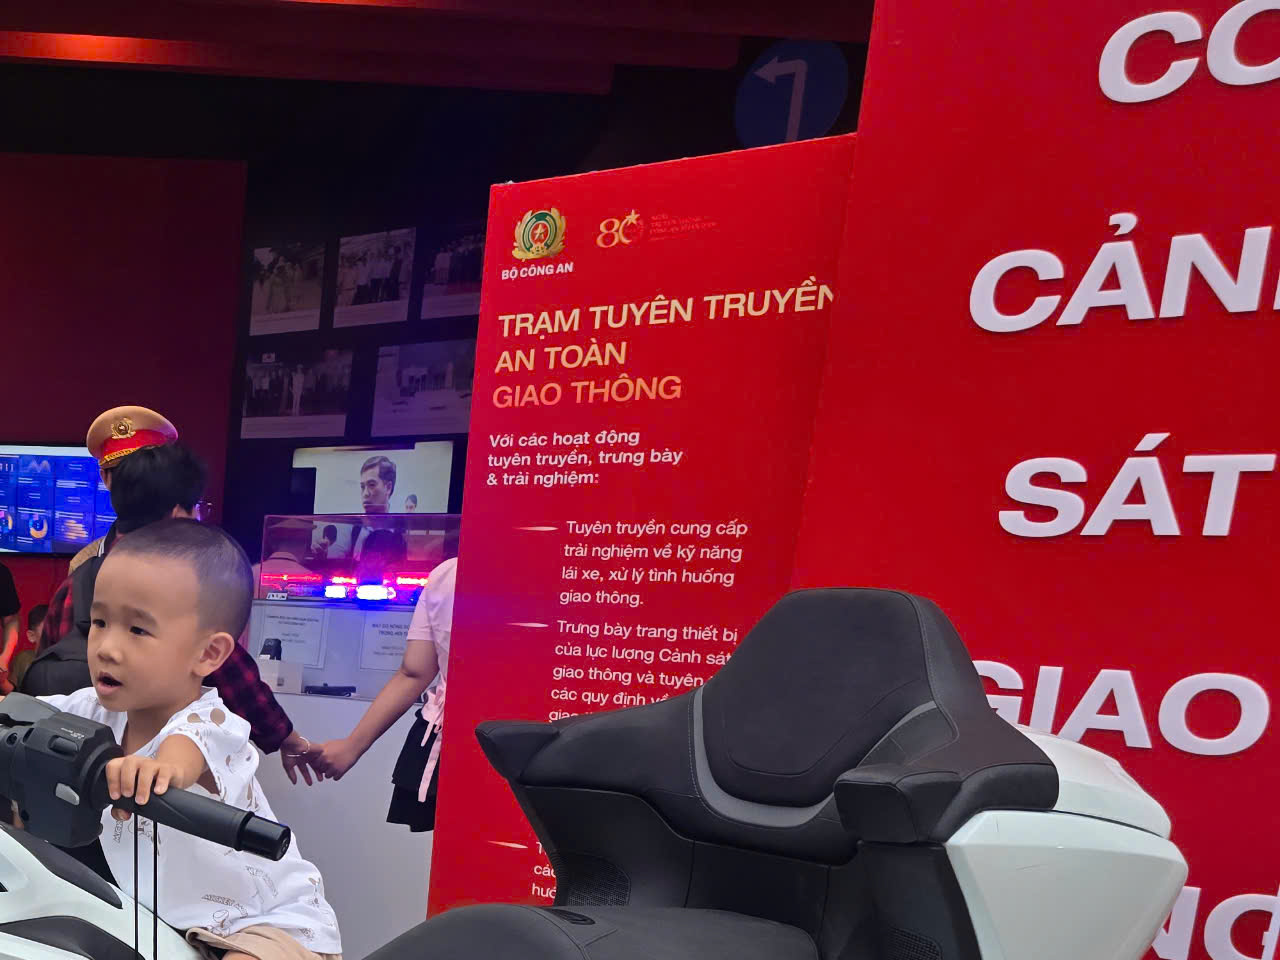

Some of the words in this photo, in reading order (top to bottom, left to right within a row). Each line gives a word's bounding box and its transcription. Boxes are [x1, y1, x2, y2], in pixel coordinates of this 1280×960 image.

[501, 266, 519, 281] BỘ
[520, 263, 554, 278] CÔNG
[556, 262, 574, 273] AN
[969, 212, 1280, 333] CẢN
[498, 308, 581, 340] TRẠM
[589, 294, 694, 330] TUYÊN
[704, 275, 834, 320] TRUYỀN
[494, 349, 536, 373] AN
[544, 337, 627, 370] TOÀN
[492, 382, 562, 409] GIAO
[571, 373, 682, 404] THÔNG
[489, 433, 514, 448] Với
[518, 432, 547, 447] các
[552, 431, 590, 448] hoạt
[595, 429, 640, 447] động
[487, 452, 531, 469] tuyên
[536, 448, 593, 467] truyền,
[598, 450, 645, 467] trưng
[650, 448, 683, 466] bày
[486, 473, 498, 486] &
[503, 471, 529, 486] trải
[533, 471, 600, 487] nghiệm:
[998, 432, 1277, 538] SÁT
[566, 520, 612, 537] Tuyên
[616, 518, 665, 538] truyền
[670, 523, 711, 538] cung
[715, 518, 748, 538] cấp
[564, 542, 588, 557] trải
[592, 544, 649, 560] nghiệm
[653, 543, 672, 559] về
[677, 544, 696, 562] kỹ
[700, 546, 742, 563] năng
[562, 566, 578, 580] lái
[581, 568, 604, 582] xe,
[609, 566, 628, 581] xử
[632, 567, 645, 585] lý
[648, 568, 677, 583] tình
[681, 567, 735, 587] huống
[559, 590, 592, 605] giao
[596, 590, 644, 608] thông.
[557, 619, 600, 638] Trưng
[603, 622, 632, 640] bày
[636, 624, 677, 642] trang
[682, 625, 718, 641] thiết
[722, 627, 738, 645] bị
[554, 641, 582, 657] của
[586, 644, 608, 660] lực
[612, 645, 654, 664] lượng
[659, 648, 701, 664] Cảnh
[552, 665, 584, 680] giao
[588, 667, 632, 685] thông
[636, 669, 655, 684] và
[659, 672, 704, 688] tuyên
[550, 688, 577, 701] các
[581, 690, 609, 706] quy
[613, 691, 646, 708] định
[548, 710, 579, 723] gia
